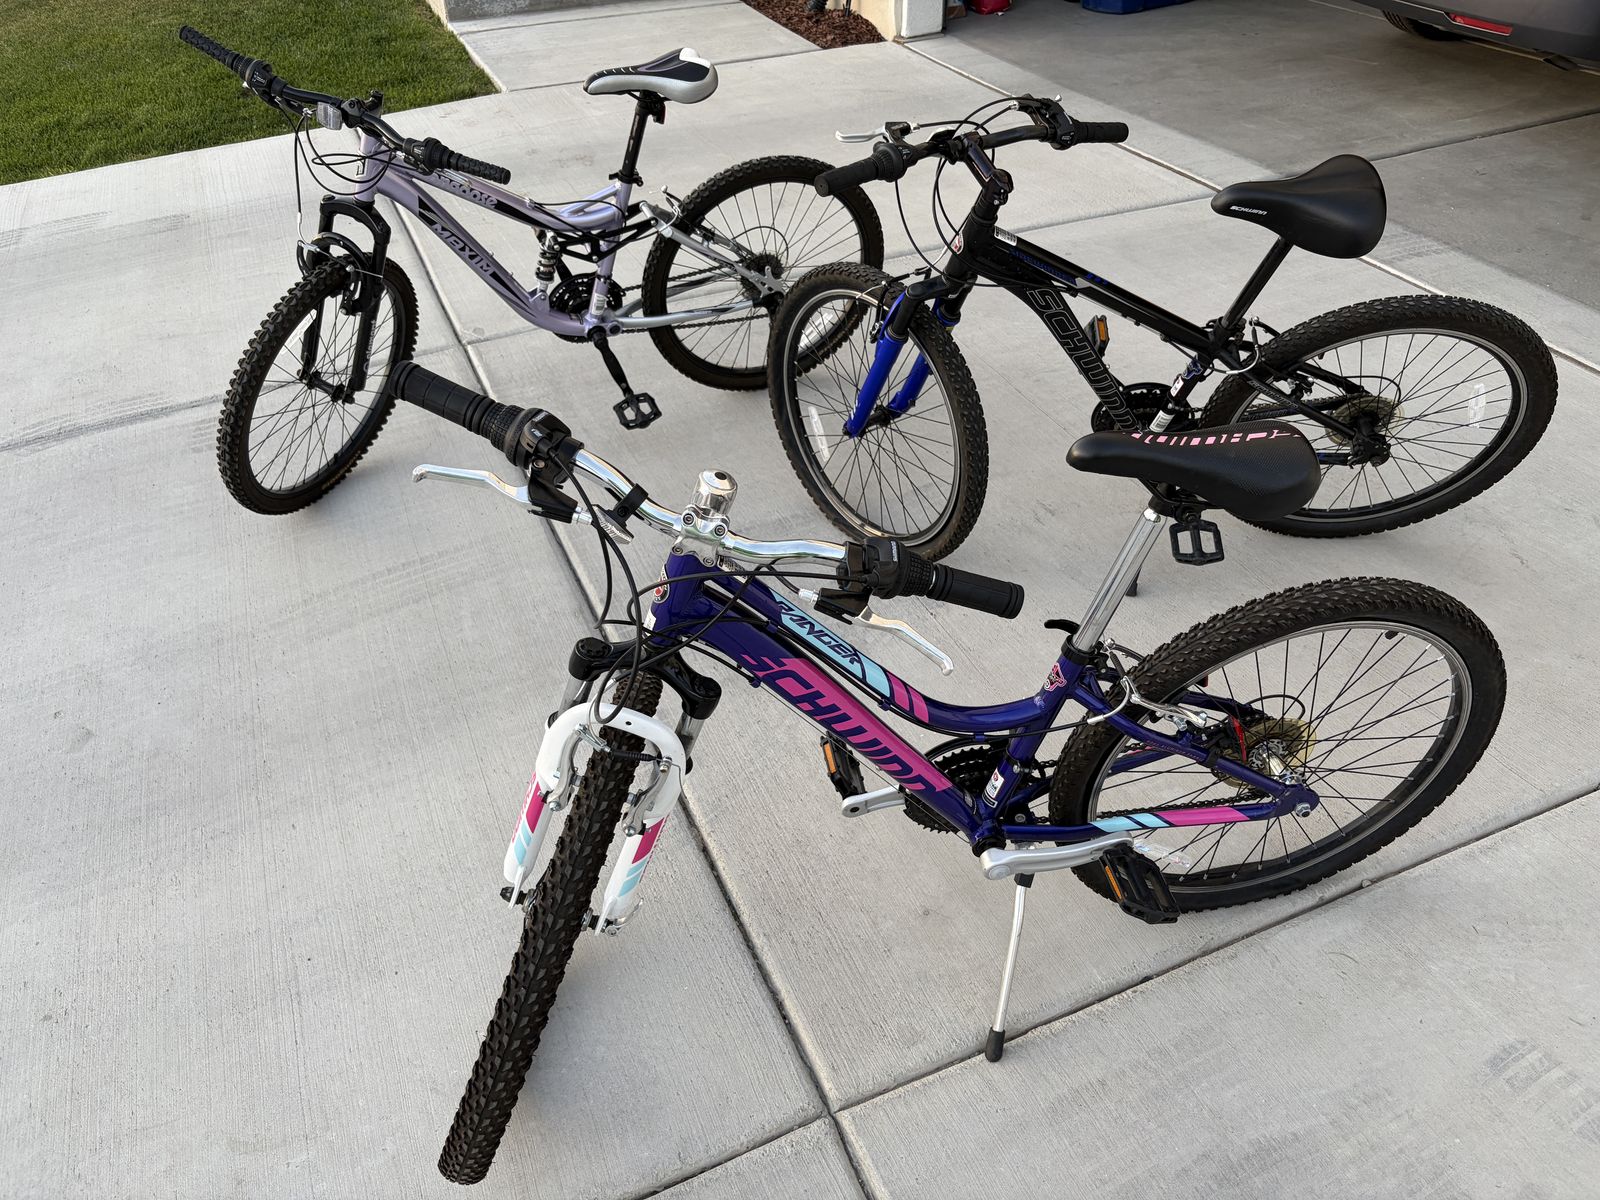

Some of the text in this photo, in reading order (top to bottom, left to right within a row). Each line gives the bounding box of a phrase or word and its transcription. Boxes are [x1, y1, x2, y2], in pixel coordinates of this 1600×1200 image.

[1026, 288, 1138, 431] SCHWINN
[776, 600, 862, 666] RANGER
[740, 654, 938, 792] SCHWINN
